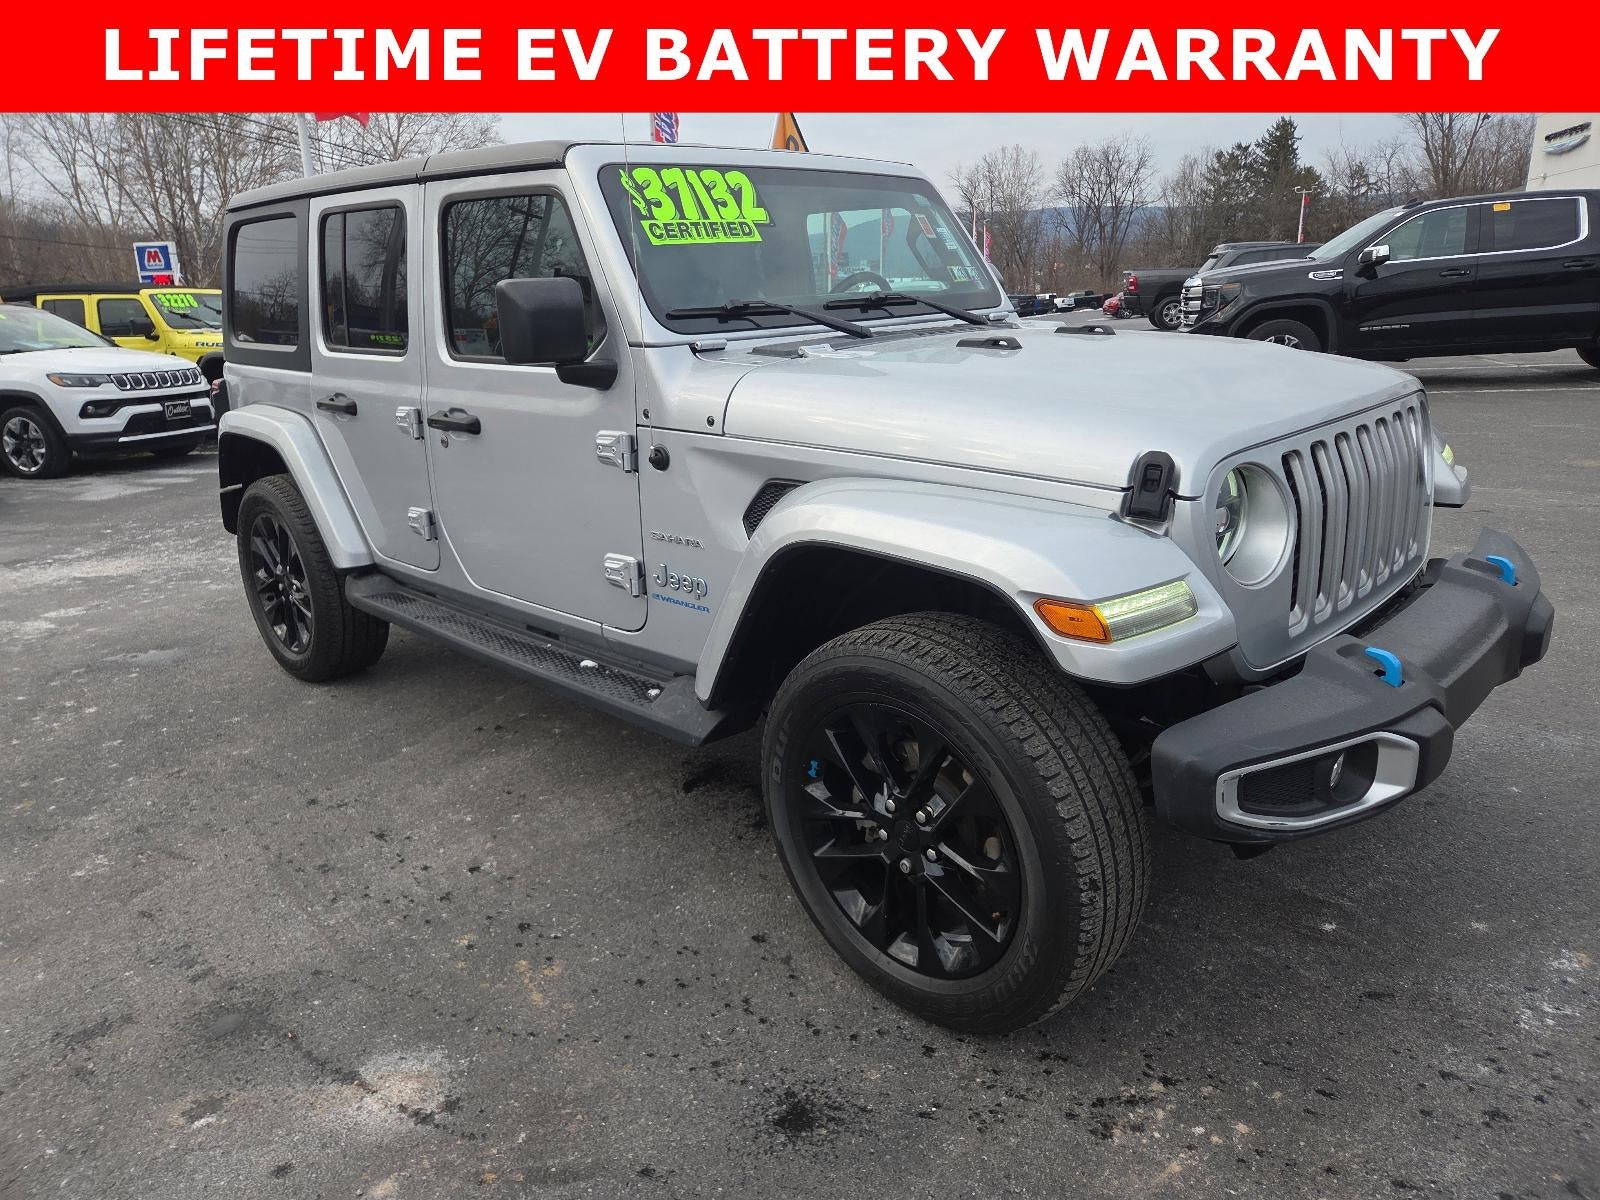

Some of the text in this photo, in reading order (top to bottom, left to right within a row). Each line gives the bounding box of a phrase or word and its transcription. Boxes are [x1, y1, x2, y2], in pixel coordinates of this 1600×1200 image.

[619, 167, 769, 222] $37132
[648, 220, 755, 241] CERTIFIED
[652, 563, 708, 601] Jeep
